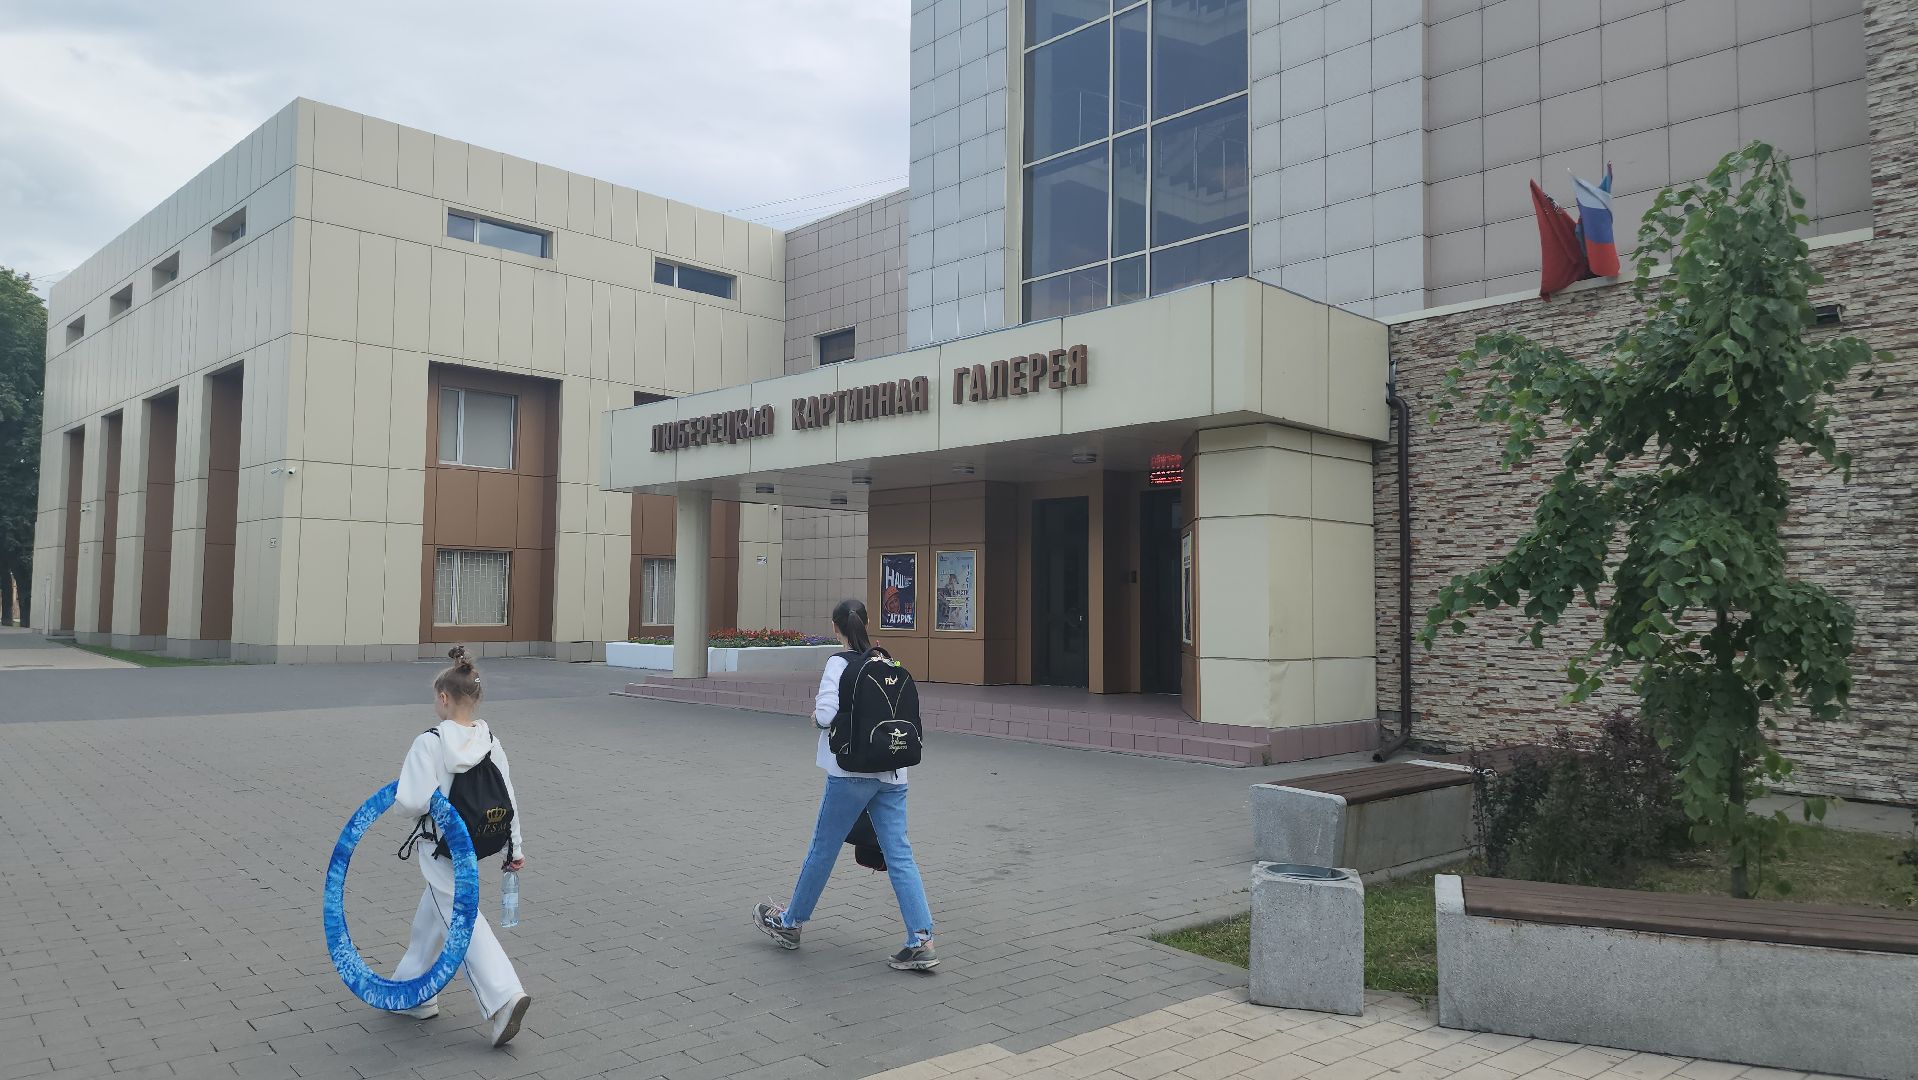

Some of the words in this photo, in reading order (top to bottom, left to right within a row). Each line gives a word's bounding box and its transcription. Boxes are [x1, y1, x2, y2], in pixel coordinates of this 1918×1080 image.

[650, 403, 775, 453] ЛЮБЕРЕЦКАЯ
[791, 375, 929, 431] КАРТИННАЯ
[952, 344, 1088, 405] ГАЛЕРЕЯ
